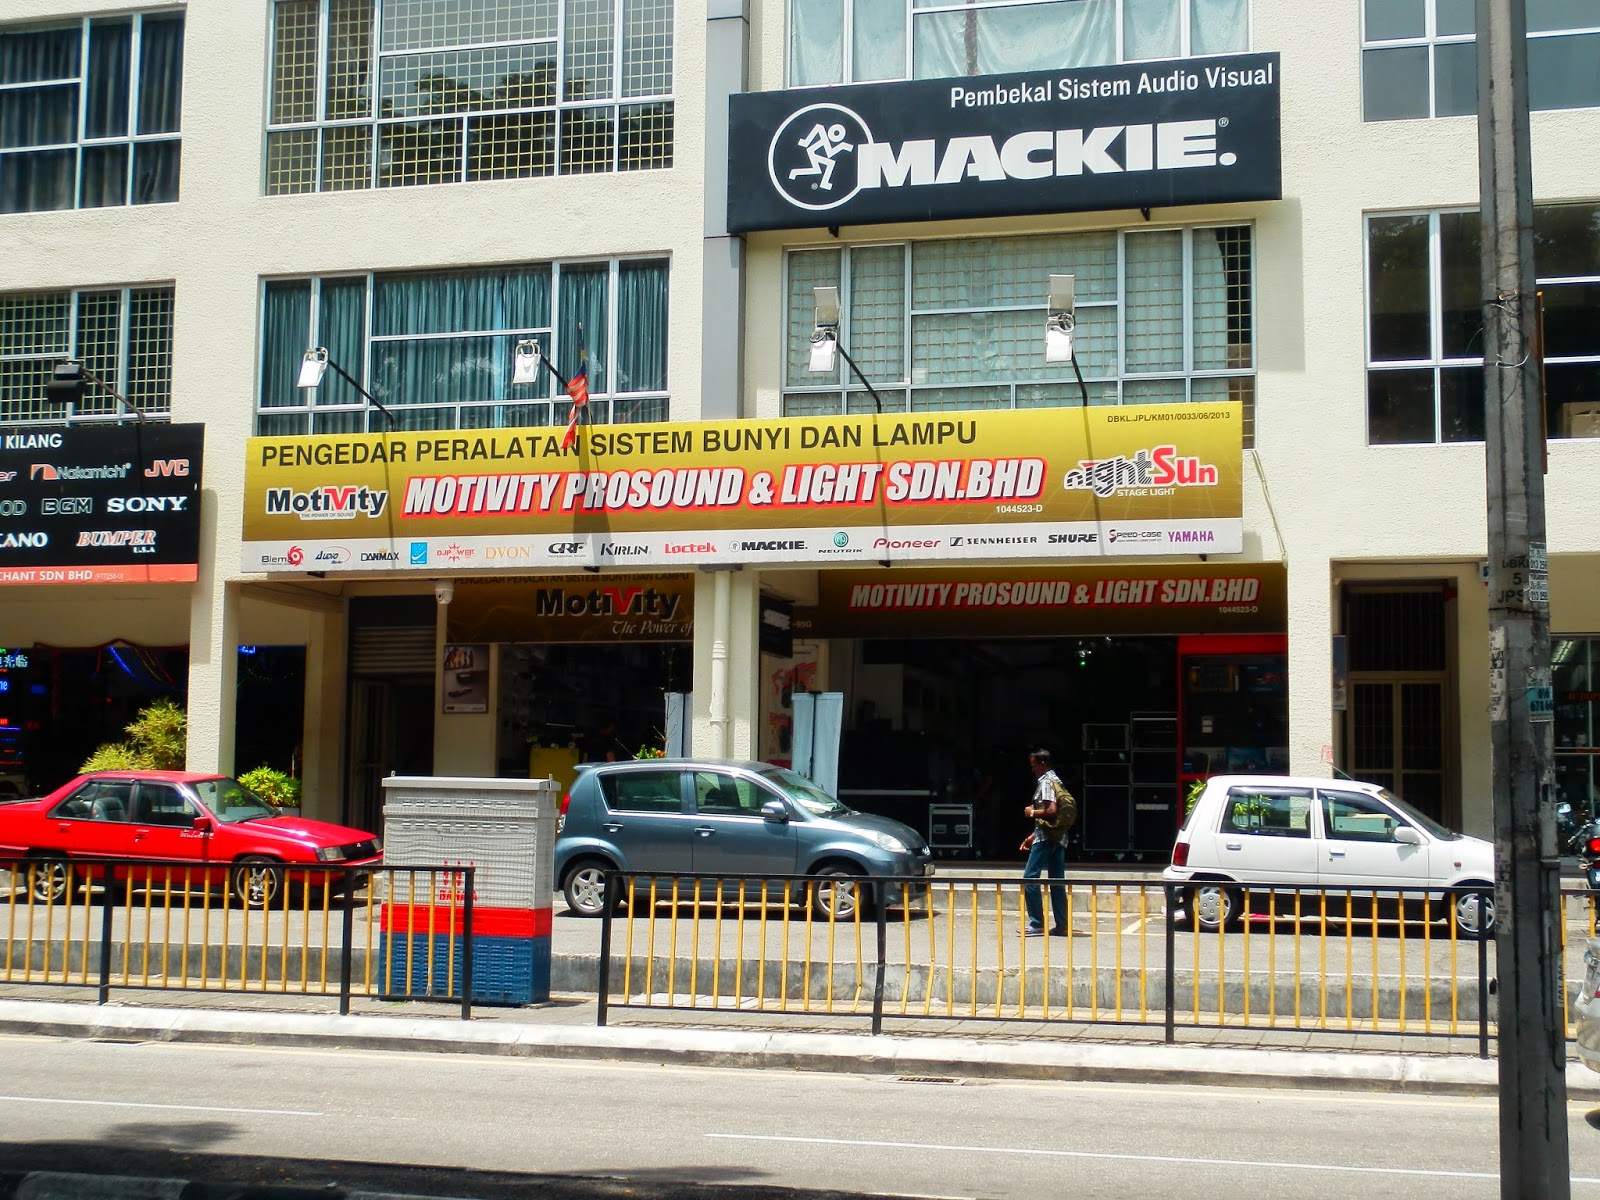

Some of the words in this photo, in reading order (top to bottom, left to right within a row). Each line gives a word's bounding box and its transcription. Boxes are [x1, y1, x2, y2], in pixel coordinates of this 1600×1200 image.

[950, 81, 1052, 108] Pembekal
[1058, 77, 1131, 101] Sistem
[1136, 71, 1200, 95] Audio
[1204, 63, 1273, 89] Visual
[6, 433, 63, 449] KILANG
[262, 442, 406, 467] PENGEDAR
[416, 435, 581, 462] PERALATAN
[590, 430, 693, 457] SISTEM
[703, 427, 790, 452] BUNYI
[800, 424, 862, 449] DAN
[872, 420, 977, 447] LAMPU
[57, 464, 127, 480] Nakamichi
[144, 459, 189, 478] JVC
[403, 473, 561, 515] MOTIVITY
[562, 467, 744, 510] PROSOUND
[748, 471, 775, 504] &
[780, 463, 883, 504] LIGHT
[886, 457, 1044, 501] SDN.BHD
[1117, 488, 1148, 497] STAGE
[1149, 487, 1176, 496] LIGHT
[41, 497, 93, 515] BGM
[106, 496, 188, 513] SONY
[995, 504, 1043, 514] 1044523-D
[76, 530, 156, 547] BUMPER
[873, 538, 941, 549] Pioneer
[966, 536, 1038, 546] SENNHEISER
[1048, 533, 1098, 544] SHURE
[1168, 531, 1214, 542] YAMAHA
[485, 546, 531, 560] DVON
[547, 542, 586, 554] CRF
[664, 541, 717, 554] Loctek
[39, 570, 64, 581] SDN
[68, 569, 93, 580] BHD
[1512, 572, 1522, 585] 5
[851, 584, 951, 608] MOTIVITY
[954, 581, 1071, 607] PROSOUND
[1073, 583, 1092, 604] &
[1094, 579, 1158, 605] LIGHT
[1160, 578, 1260, 604] SDN.BHD
[612, 621, 637, 635] The
[640, 620, 677, 635] Power
[680, 620, 695, 637] of
